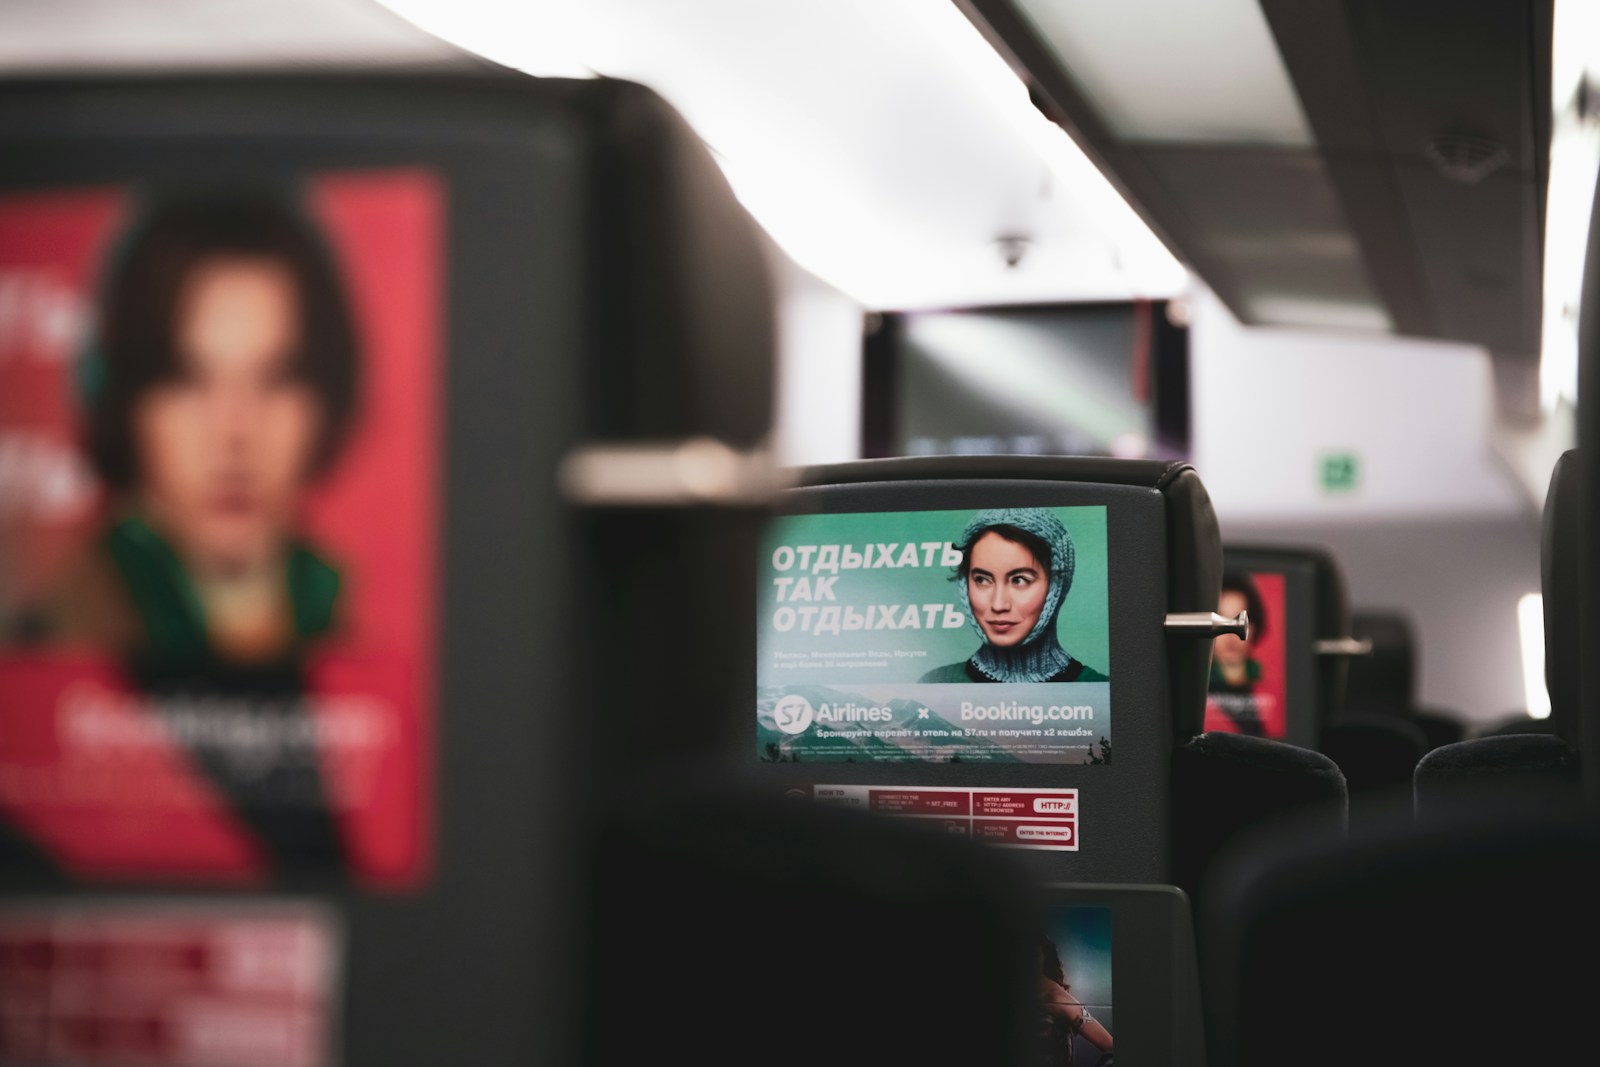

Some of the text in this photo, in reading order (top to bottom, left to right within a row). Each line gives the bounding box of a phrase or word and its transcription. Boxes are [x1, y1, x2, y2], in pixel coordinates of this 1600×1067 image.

[772, 542, 964, 575] ОТДЫХАТЬ
[773, 576, 840, 602] ТАК
[772, 604, 965, 635] ОТДЫХАТЬ
[894, 649, 928, 659] Иркутск
[816, 703, 893, 722] Airlines
[960, 701, 1093, 725] Booking.com
[816, 729, 872, 738] Бронируйте
[874, 729, 912, 738] перелёт
[922, 729, 949, 737] отель
[951, 729, 963, 737] на
[964, 728, 988, 737] S7.ru
[990, 729, 996, 737] и
[998, 729, 1042, 738] получите
[1057, 727, 1093, 737] кешбэк
[1041, 802, 1071, 810] HTTP://
